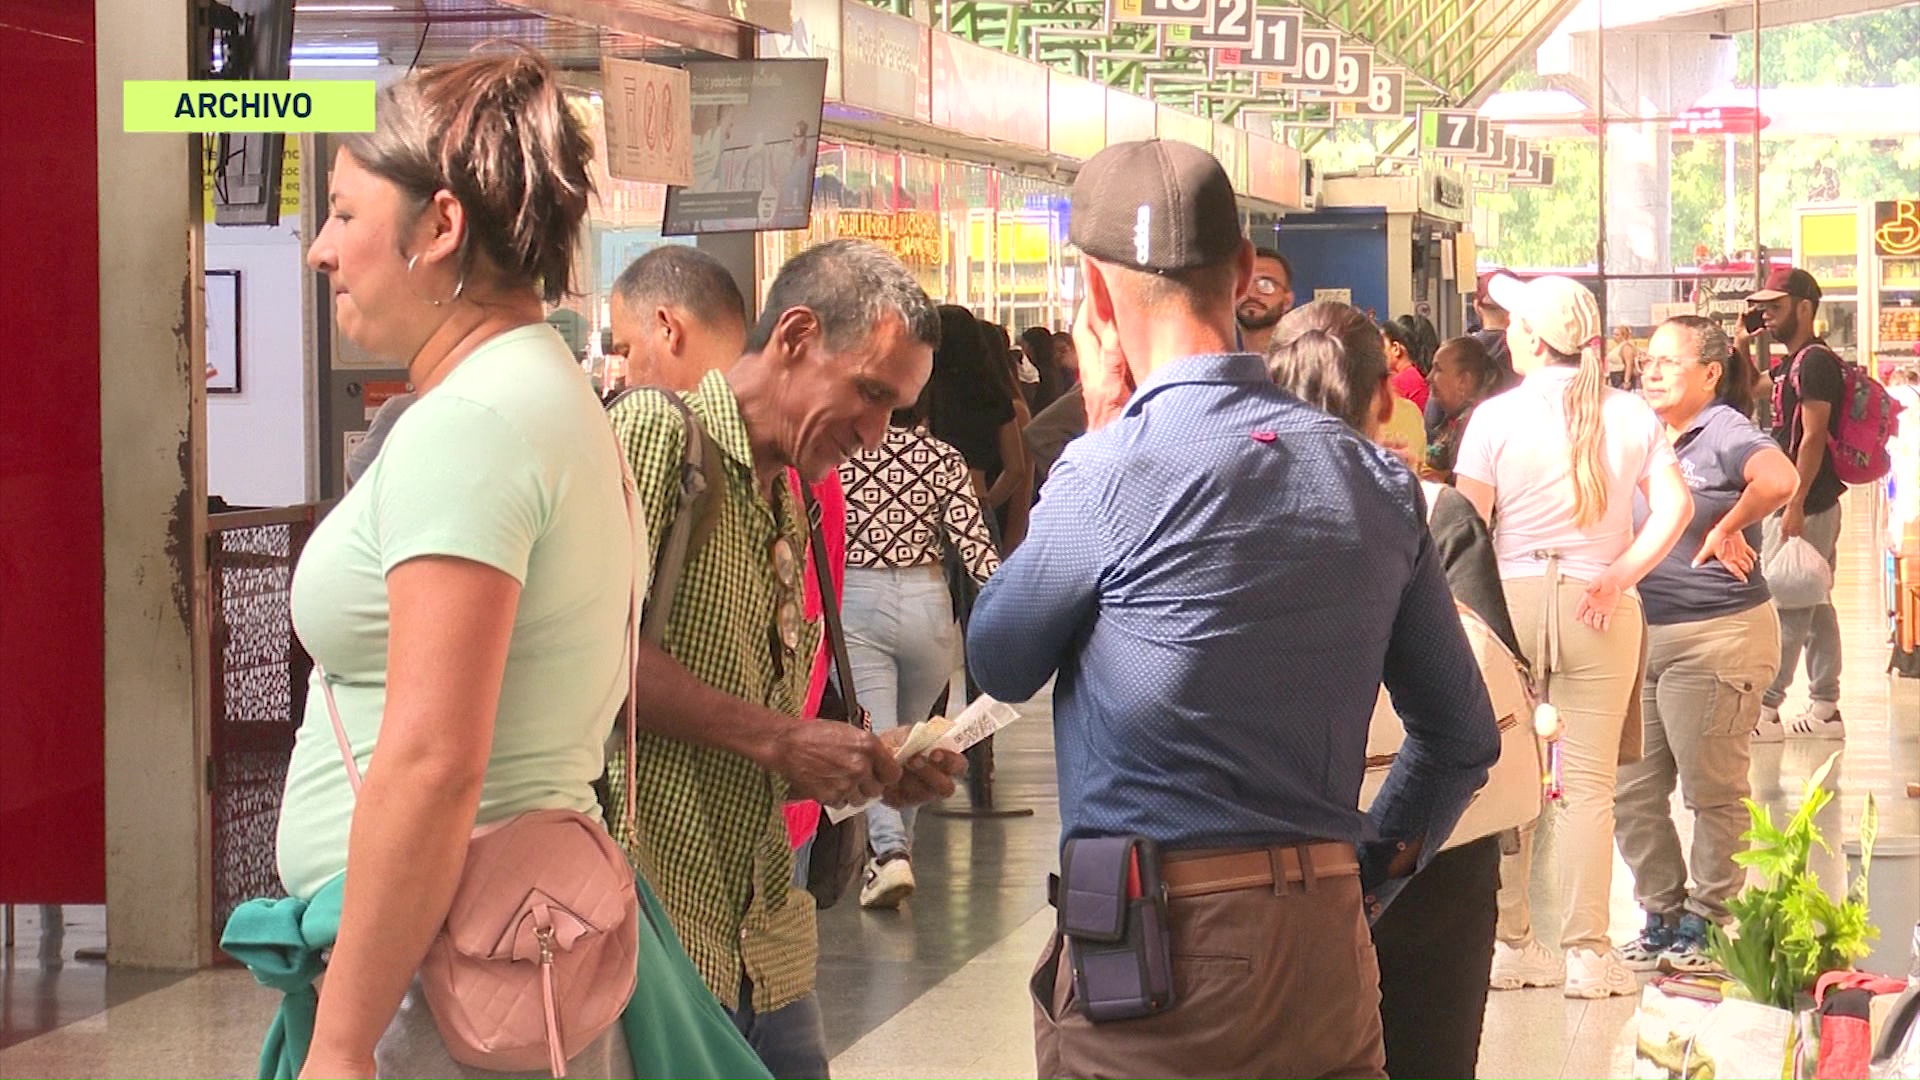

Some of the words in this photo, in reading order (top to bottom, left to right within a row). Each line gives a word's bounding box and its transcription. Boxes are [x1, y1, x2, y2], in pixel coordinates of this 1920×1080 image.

[1336, 56, 1359, 95] 9
[1368, 76, 1392, 112] 8
[1447, 116, 1468, 146] 7
